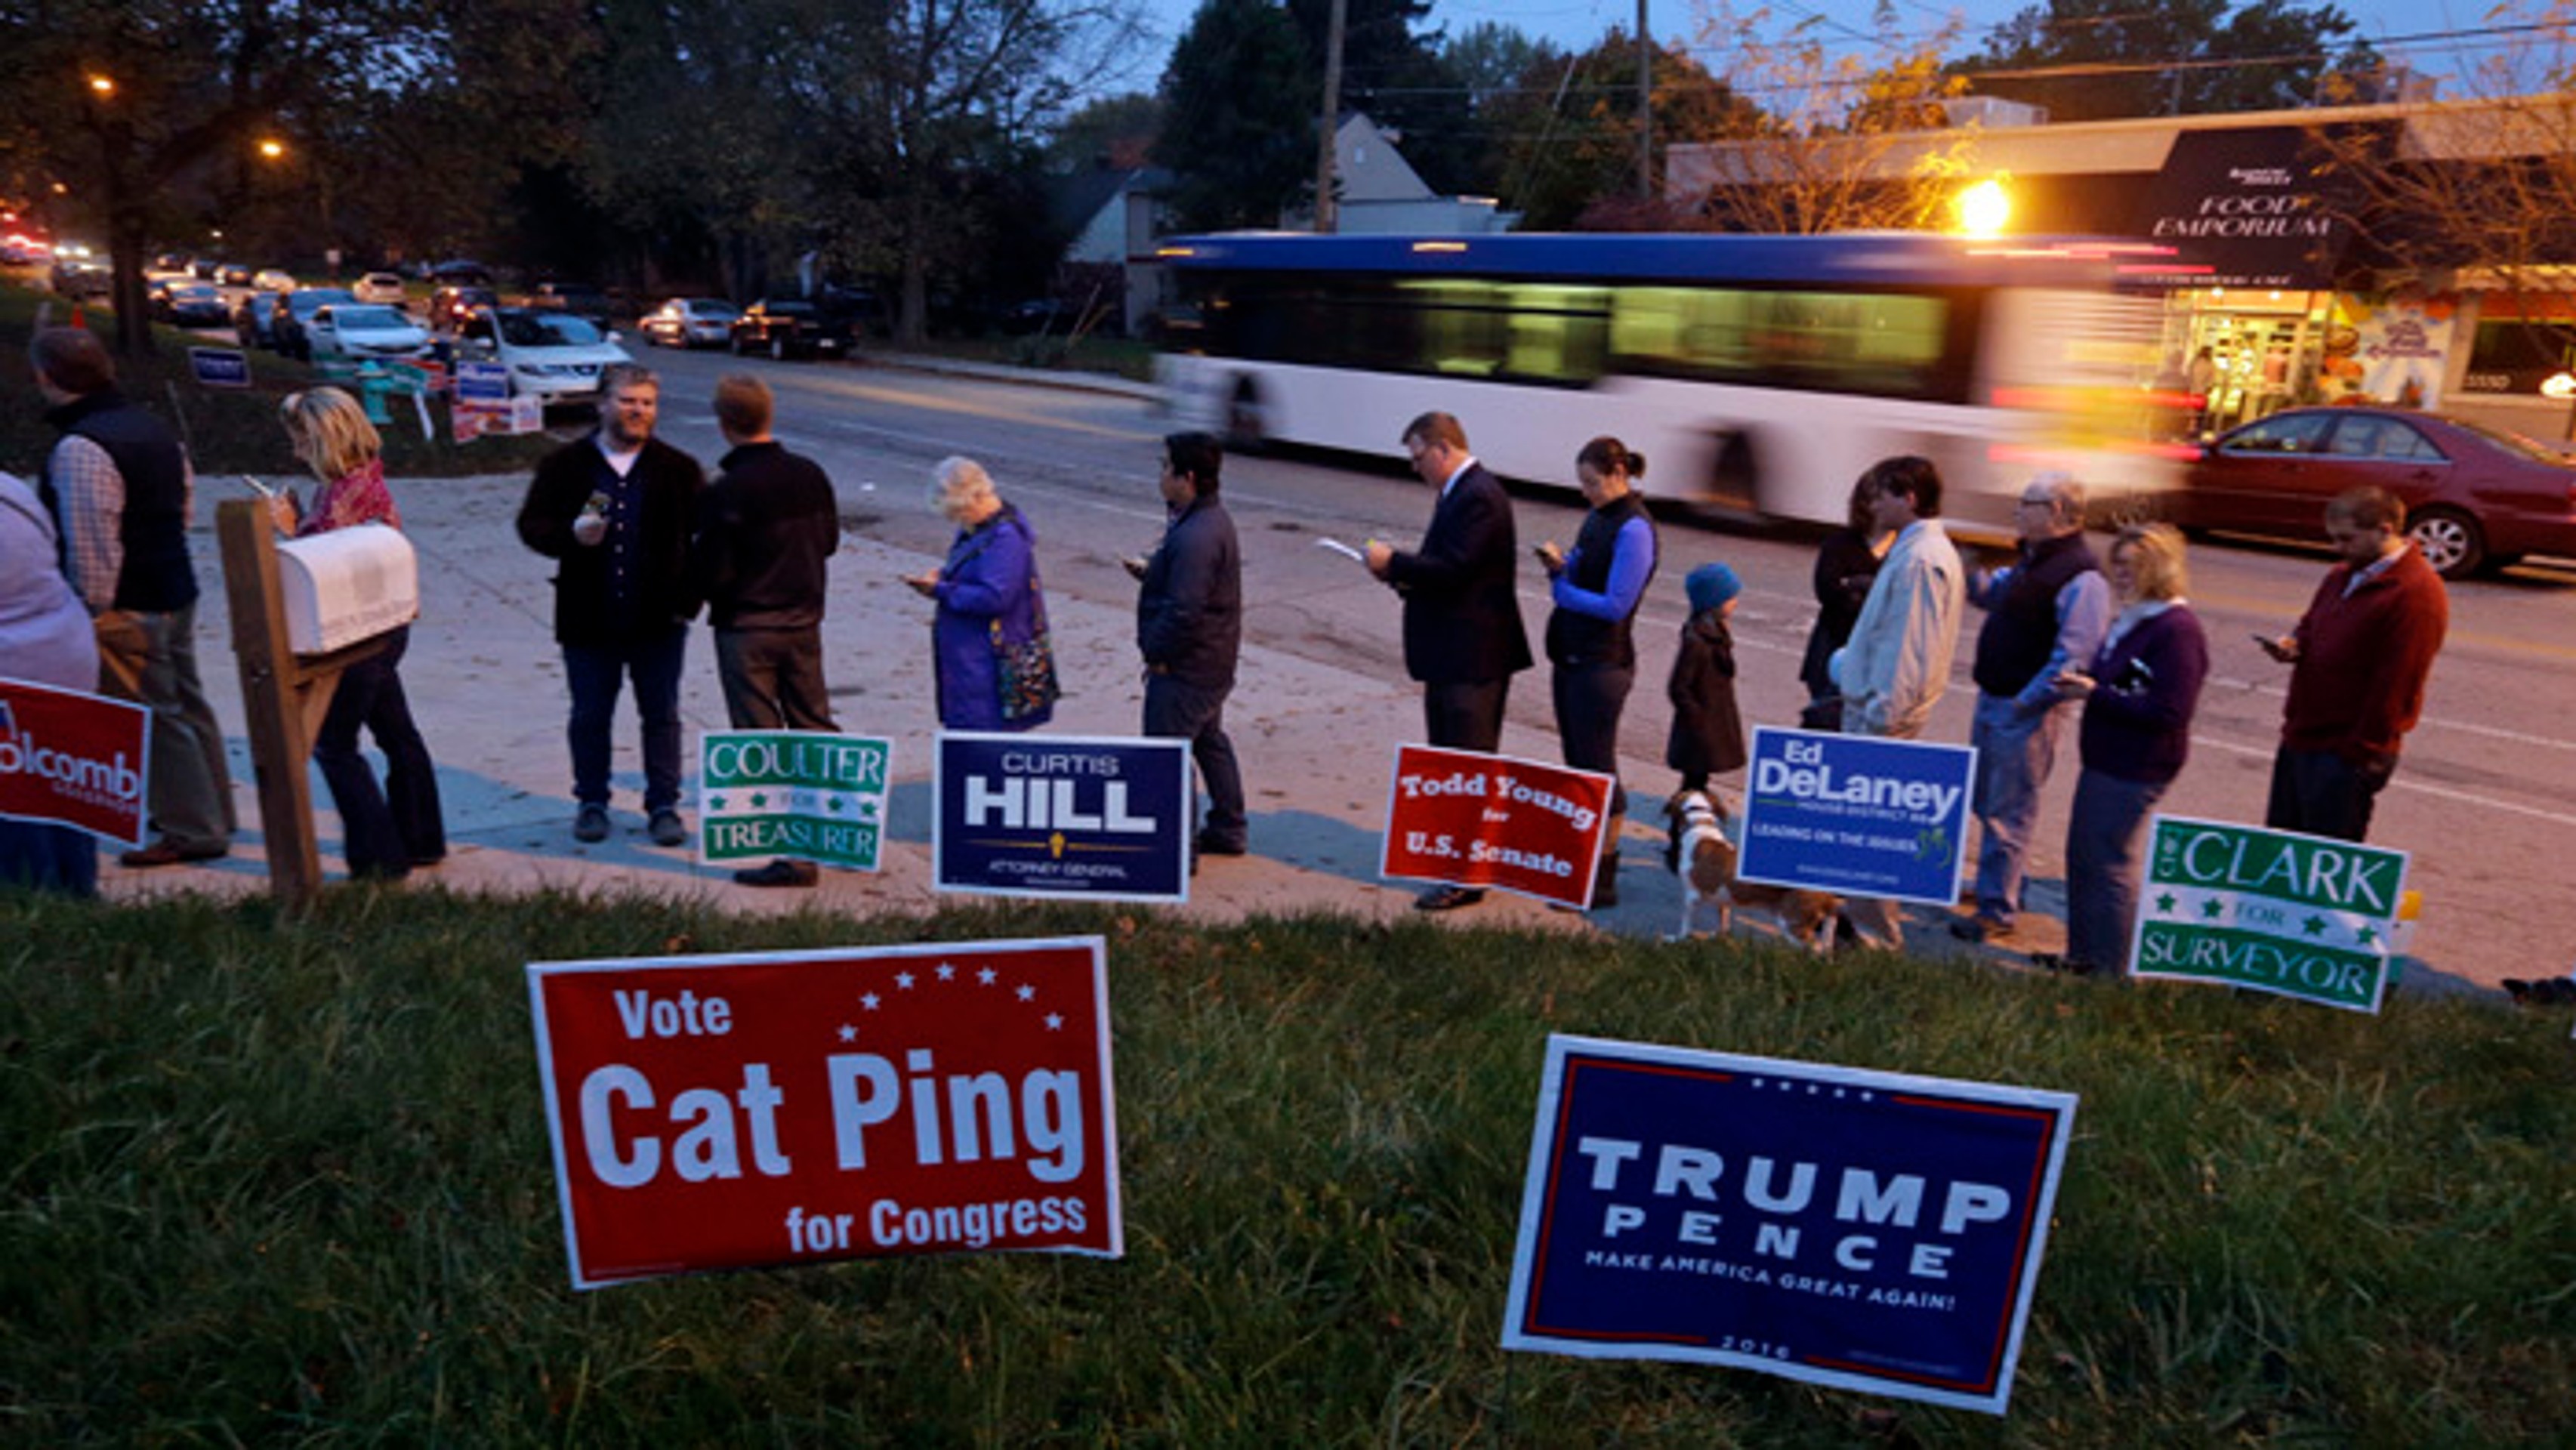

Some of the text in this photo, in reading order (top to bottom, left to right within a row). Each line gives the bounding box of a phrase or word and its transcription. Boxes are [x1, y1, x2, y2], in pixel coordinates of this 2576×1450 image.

[2153, 217, 2331, 236] EMPORIUM
[2199, 195, 2300, 214] FOOD
[709, 740, 881, 785] COULTER
[1001, 751, 1121, 776] CURTIS
[1784, 739, 1824, 765] Ed
[964, 776, 1158, 834] HILL
[1400, 773, 1597, 831] Todd Young
[1482, 806, 1510, 822] for
[1756, 758, 1962, 825] DeLaney
[709, 820, 874, 856] TREASURER
[1405, 831, 1573, 877] U.S. Senate
[1752, 822, 1812, 841] LEADING
[1814, 828, 1834, 844] ON
[1840, 831, 1865, 847] THE
[2183, 830, 2387, 911] CLARK
[2235, 902, 2287, 926] FOR
[2143, 930, 2368, 996] SURVEYOR
[613, 989, 733, 1039] Vote
[579, 1047, 1085, 1189] Cat Ping
[1578, 1137, 2012, 1235] TRUMP
[785, 1195, 1087, 1253] for Congress
[1603, 1204, 1956, 1279] PENCE
[1584, 1250, 1957, 1312] MAKE AMERICA GREAT AGAIN!
[1721, 1335, 1790, 1359] 2016
